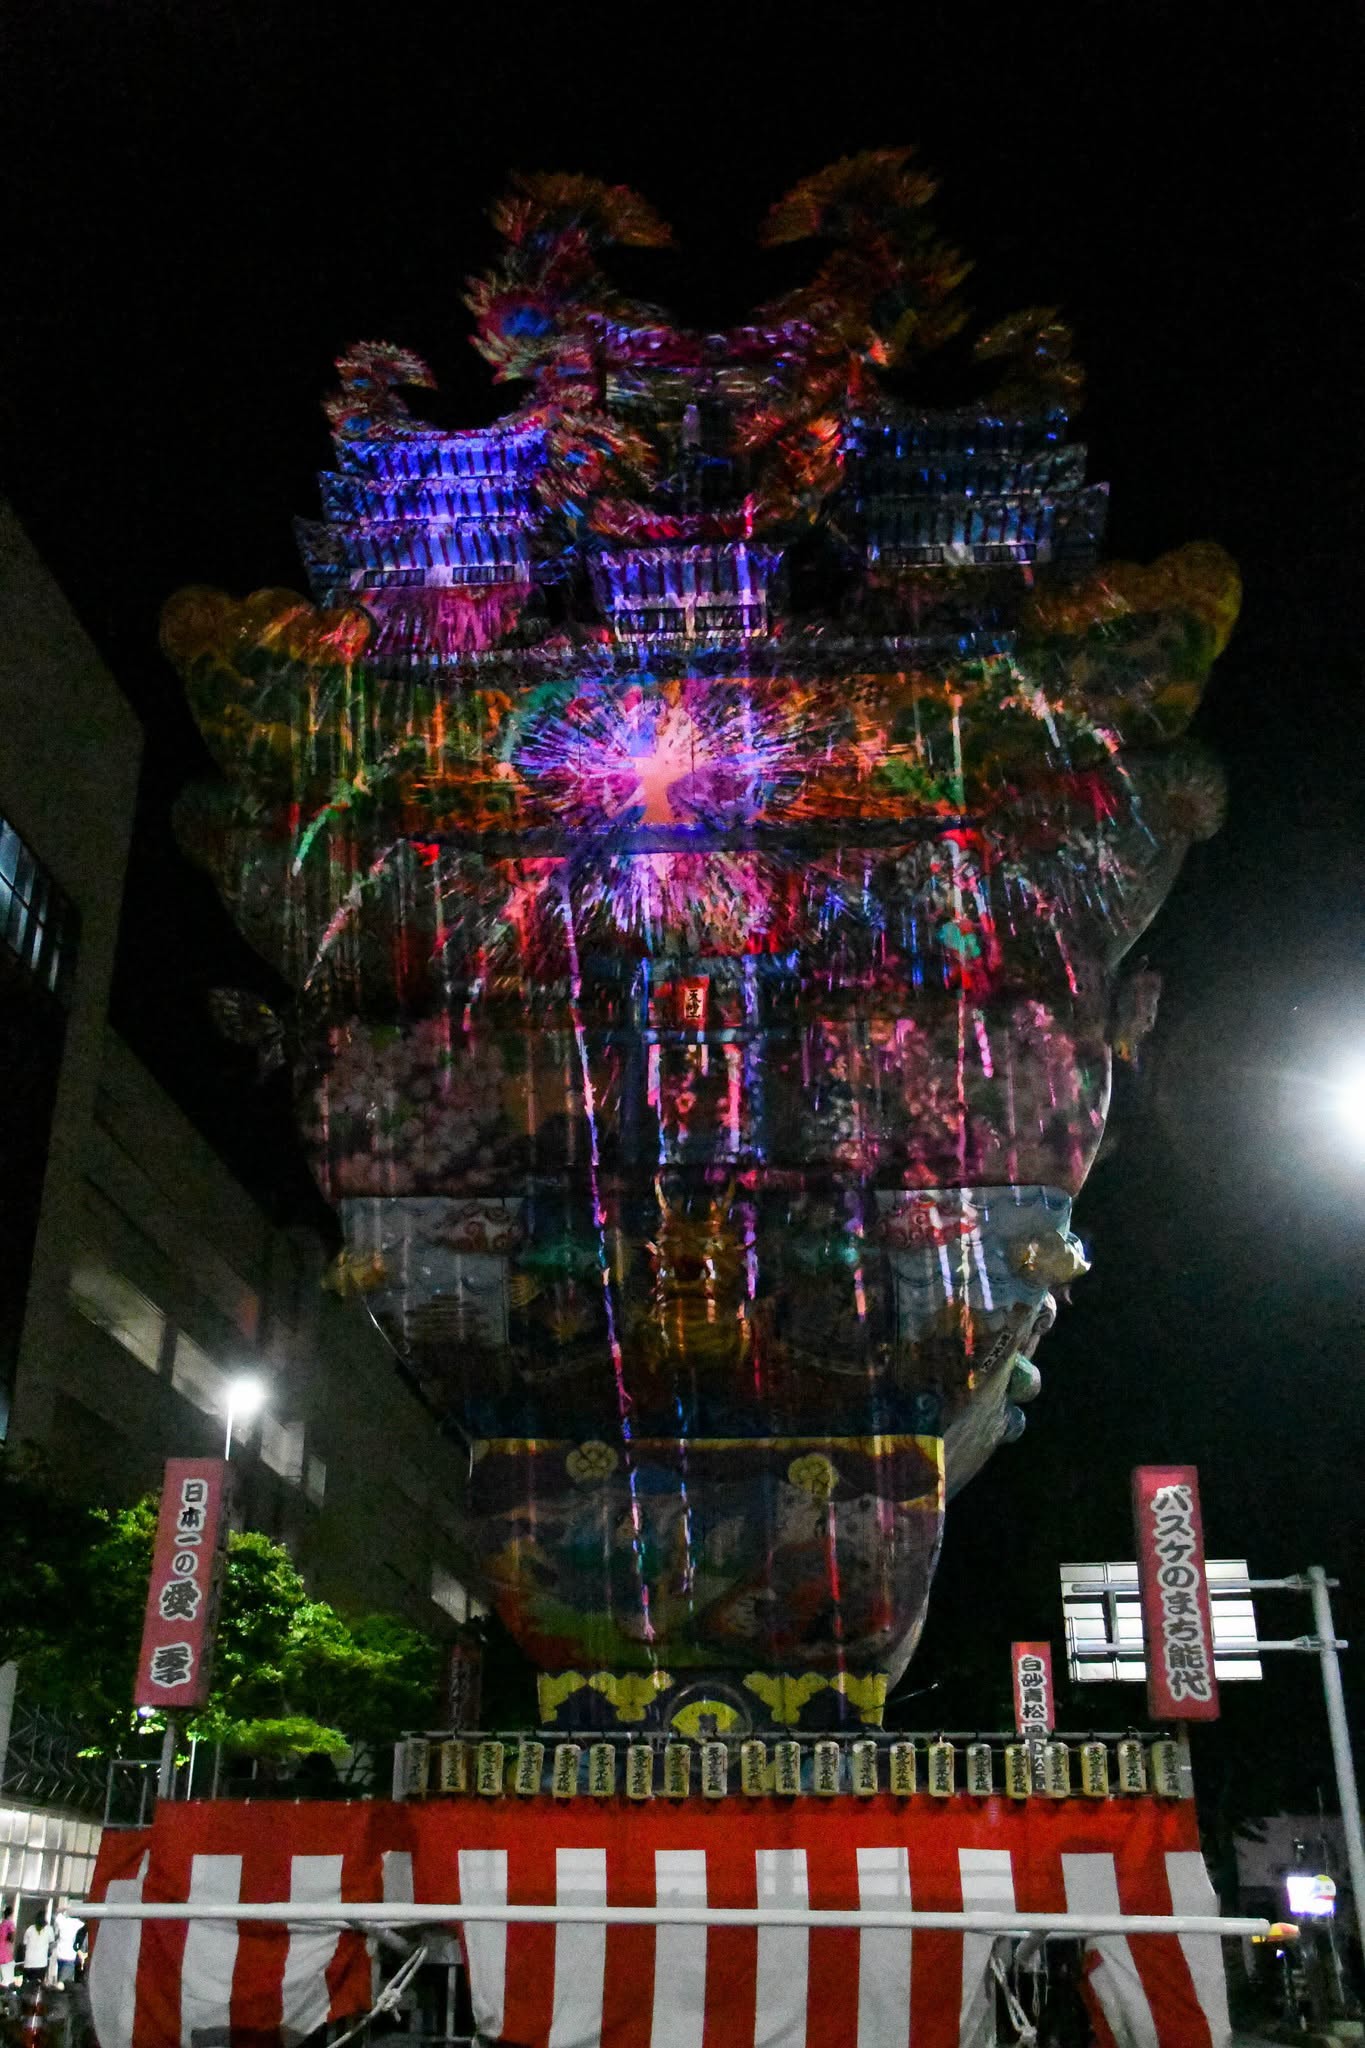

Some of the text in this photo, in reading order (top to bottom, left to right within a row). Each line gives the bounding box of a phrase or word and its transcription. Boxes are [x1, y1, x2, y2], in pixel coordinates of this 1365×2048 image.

[1153, 1486, 1211, 1699] バスケのまち能代
